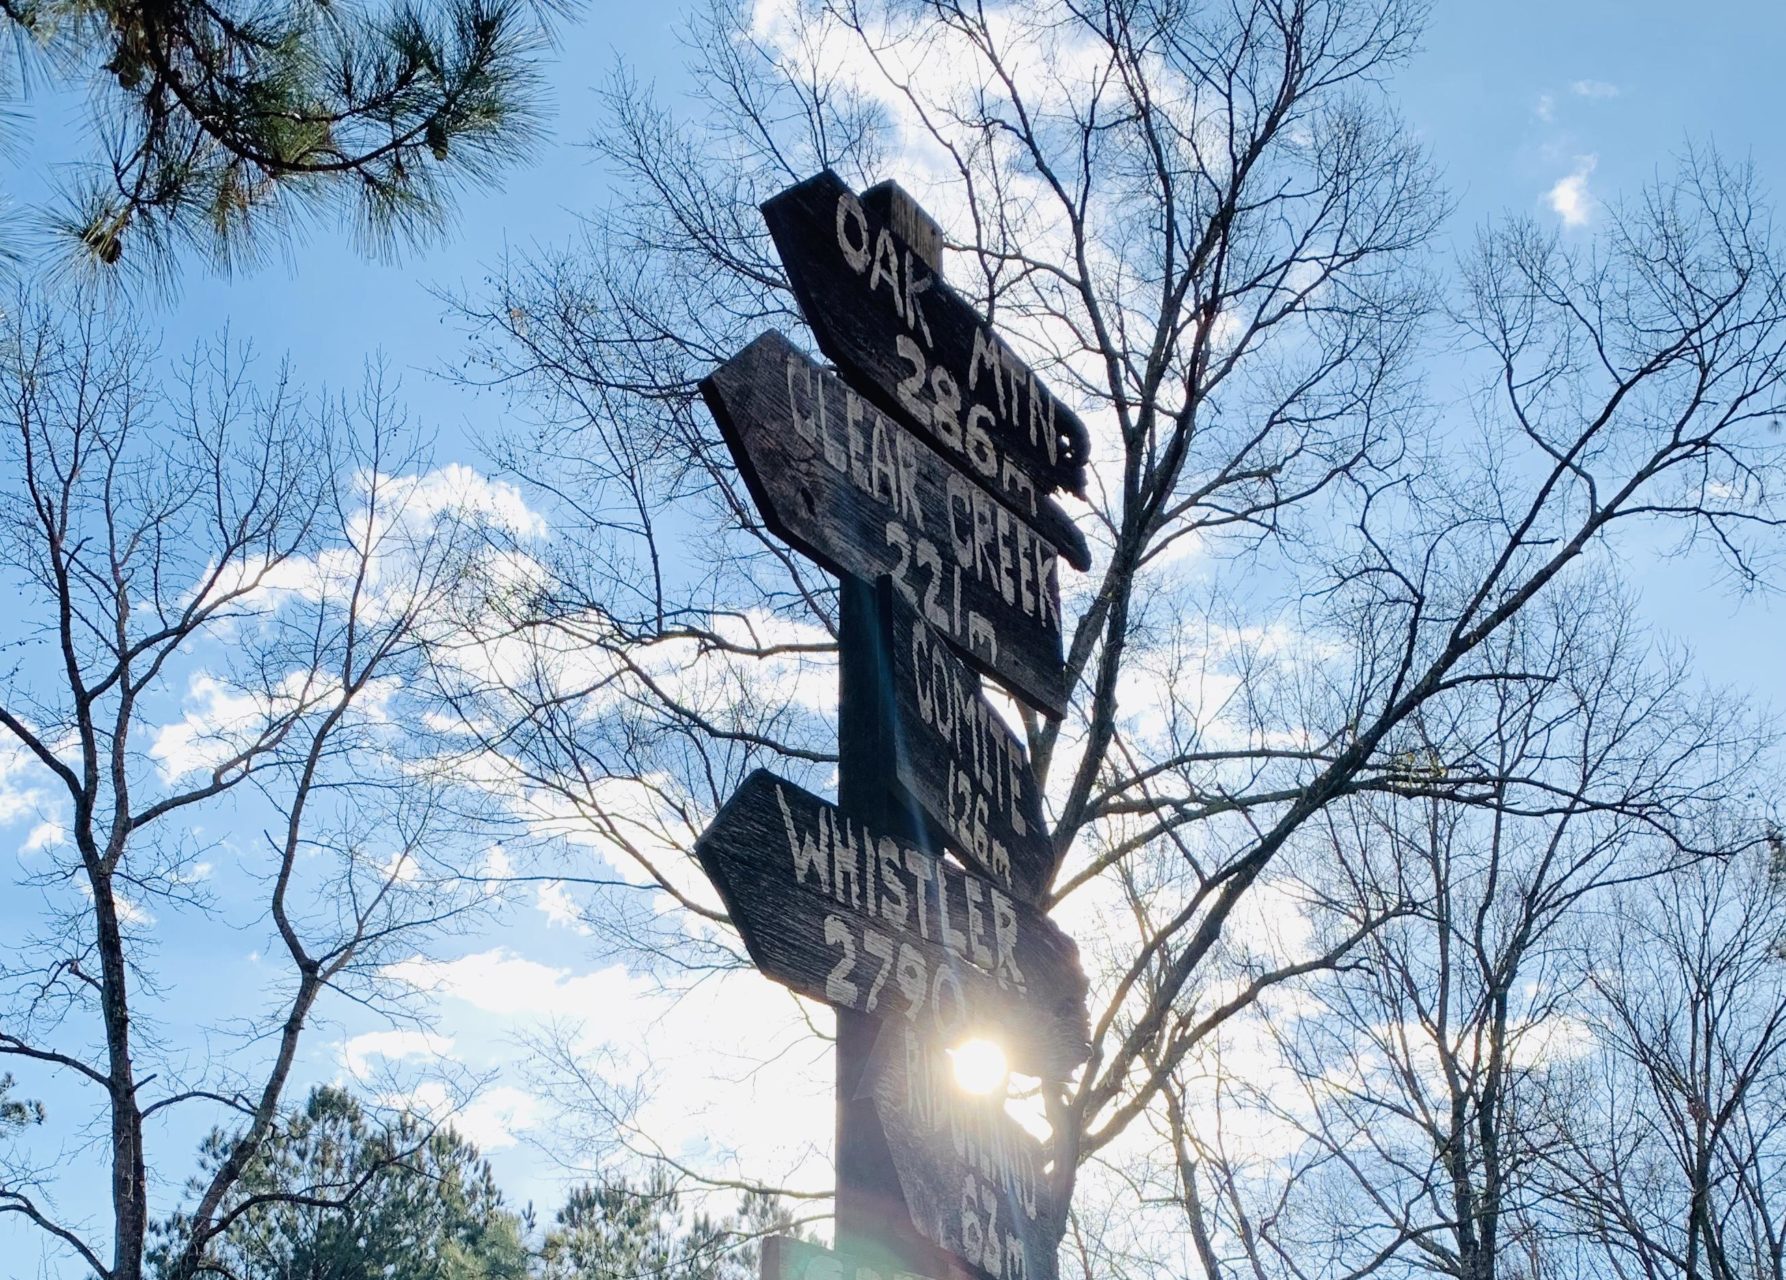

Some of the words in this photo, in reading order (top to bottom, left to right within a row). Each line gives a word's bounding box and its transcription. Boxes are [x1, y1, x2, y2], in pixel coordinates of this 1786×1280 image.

[836, 193, 933, 349] OAK
[786, 354, 925, 531] CLEAR
[946, 472, 1062, 633] CREEK
[912, 617, 1027, 838] COMITE
[776, 784, 1028, 999] WHISTLER
